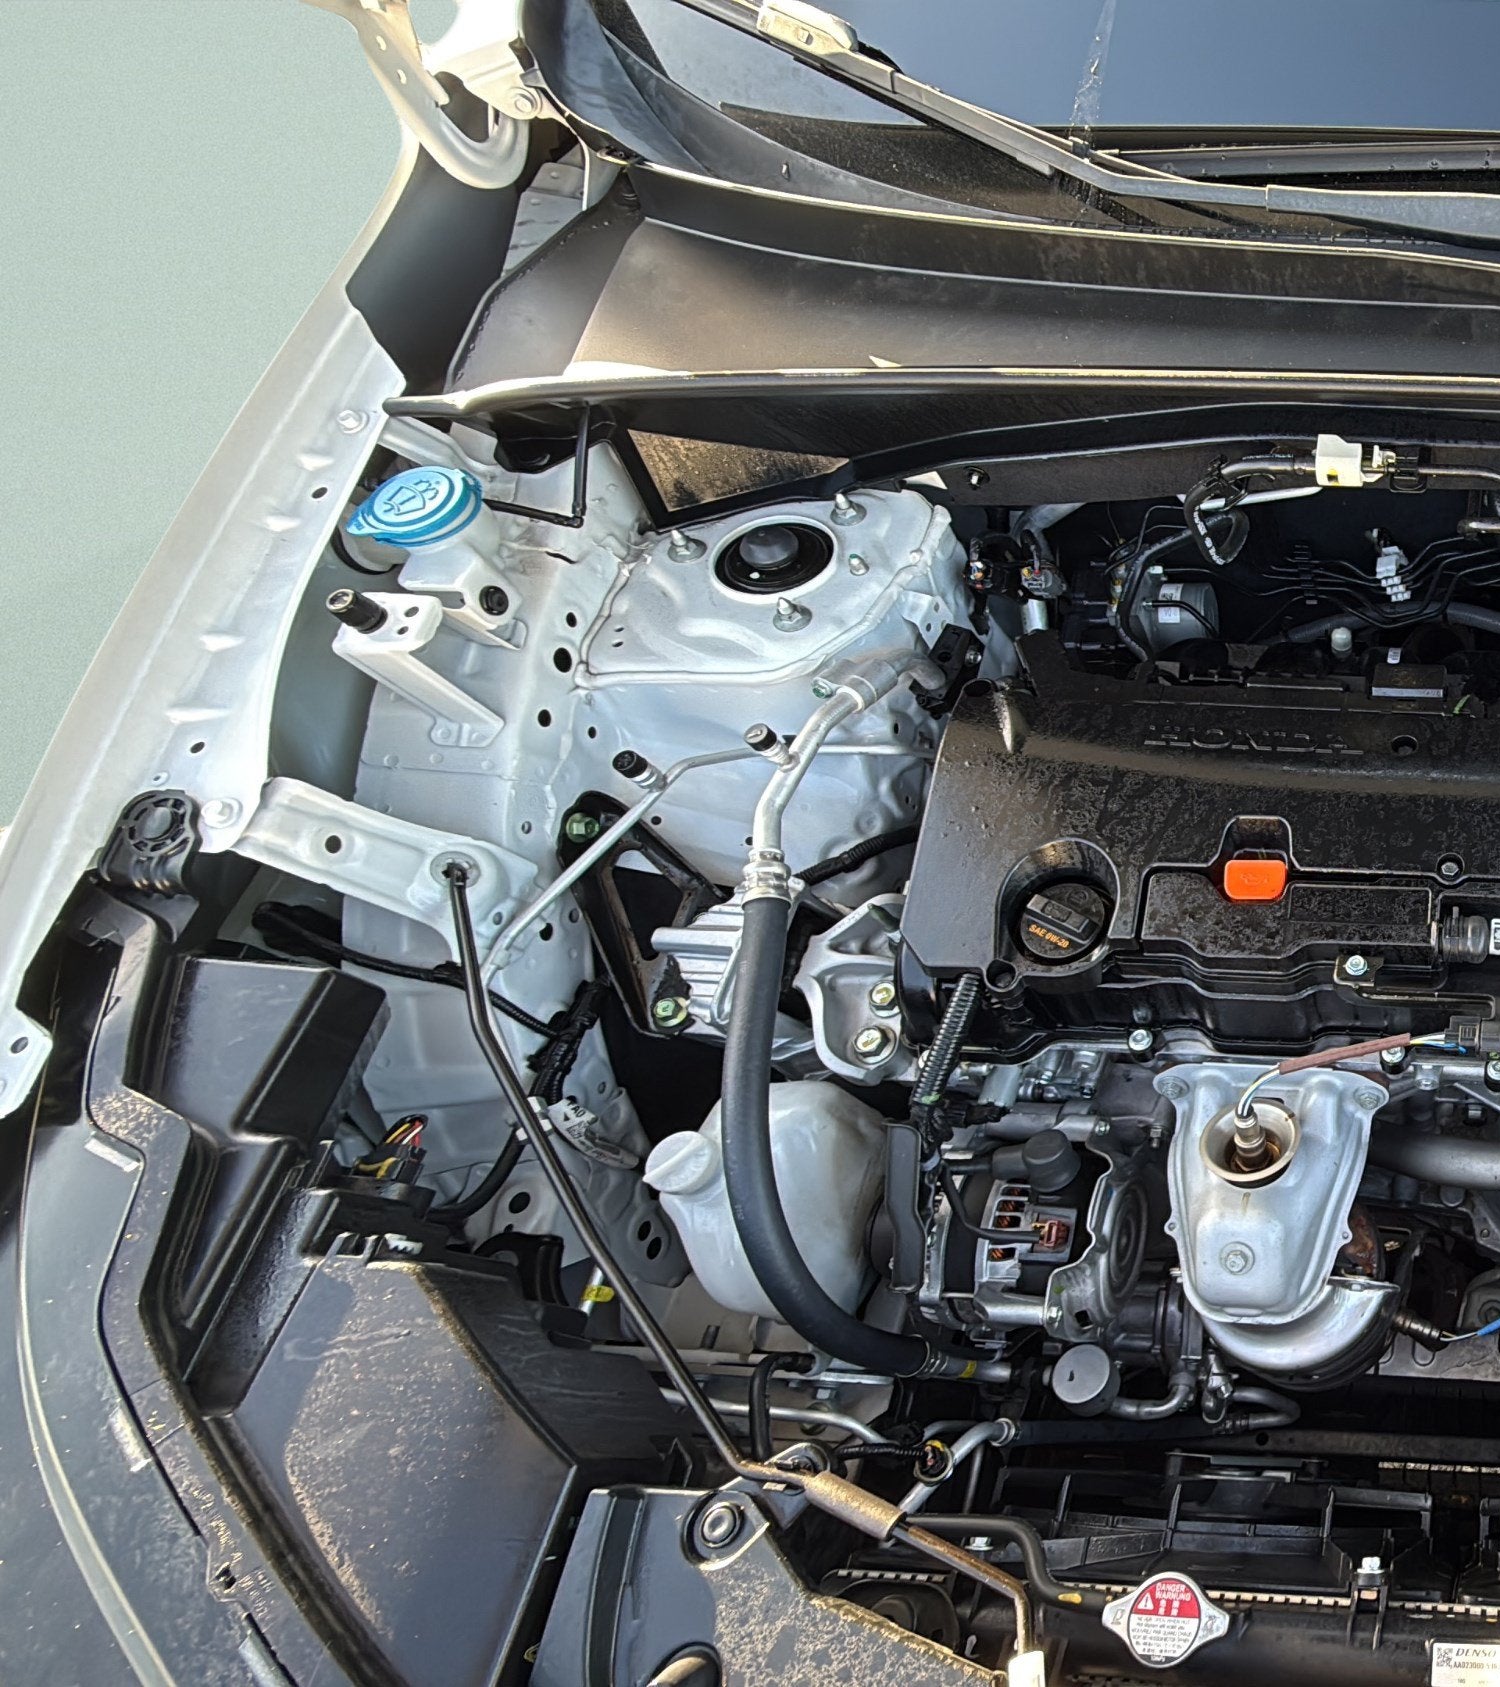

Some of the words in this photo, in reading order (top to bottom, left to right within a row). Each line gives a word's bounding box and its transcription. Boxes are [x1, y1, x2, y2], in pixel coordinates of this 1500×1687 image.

[1144, 725, 1364, 755] HONDA
[1029, 924, 1047, 937] SAE
[1045, 932, 1069, 948] 0W-20
[1455, 1648, 1497, 1657] DENSO
